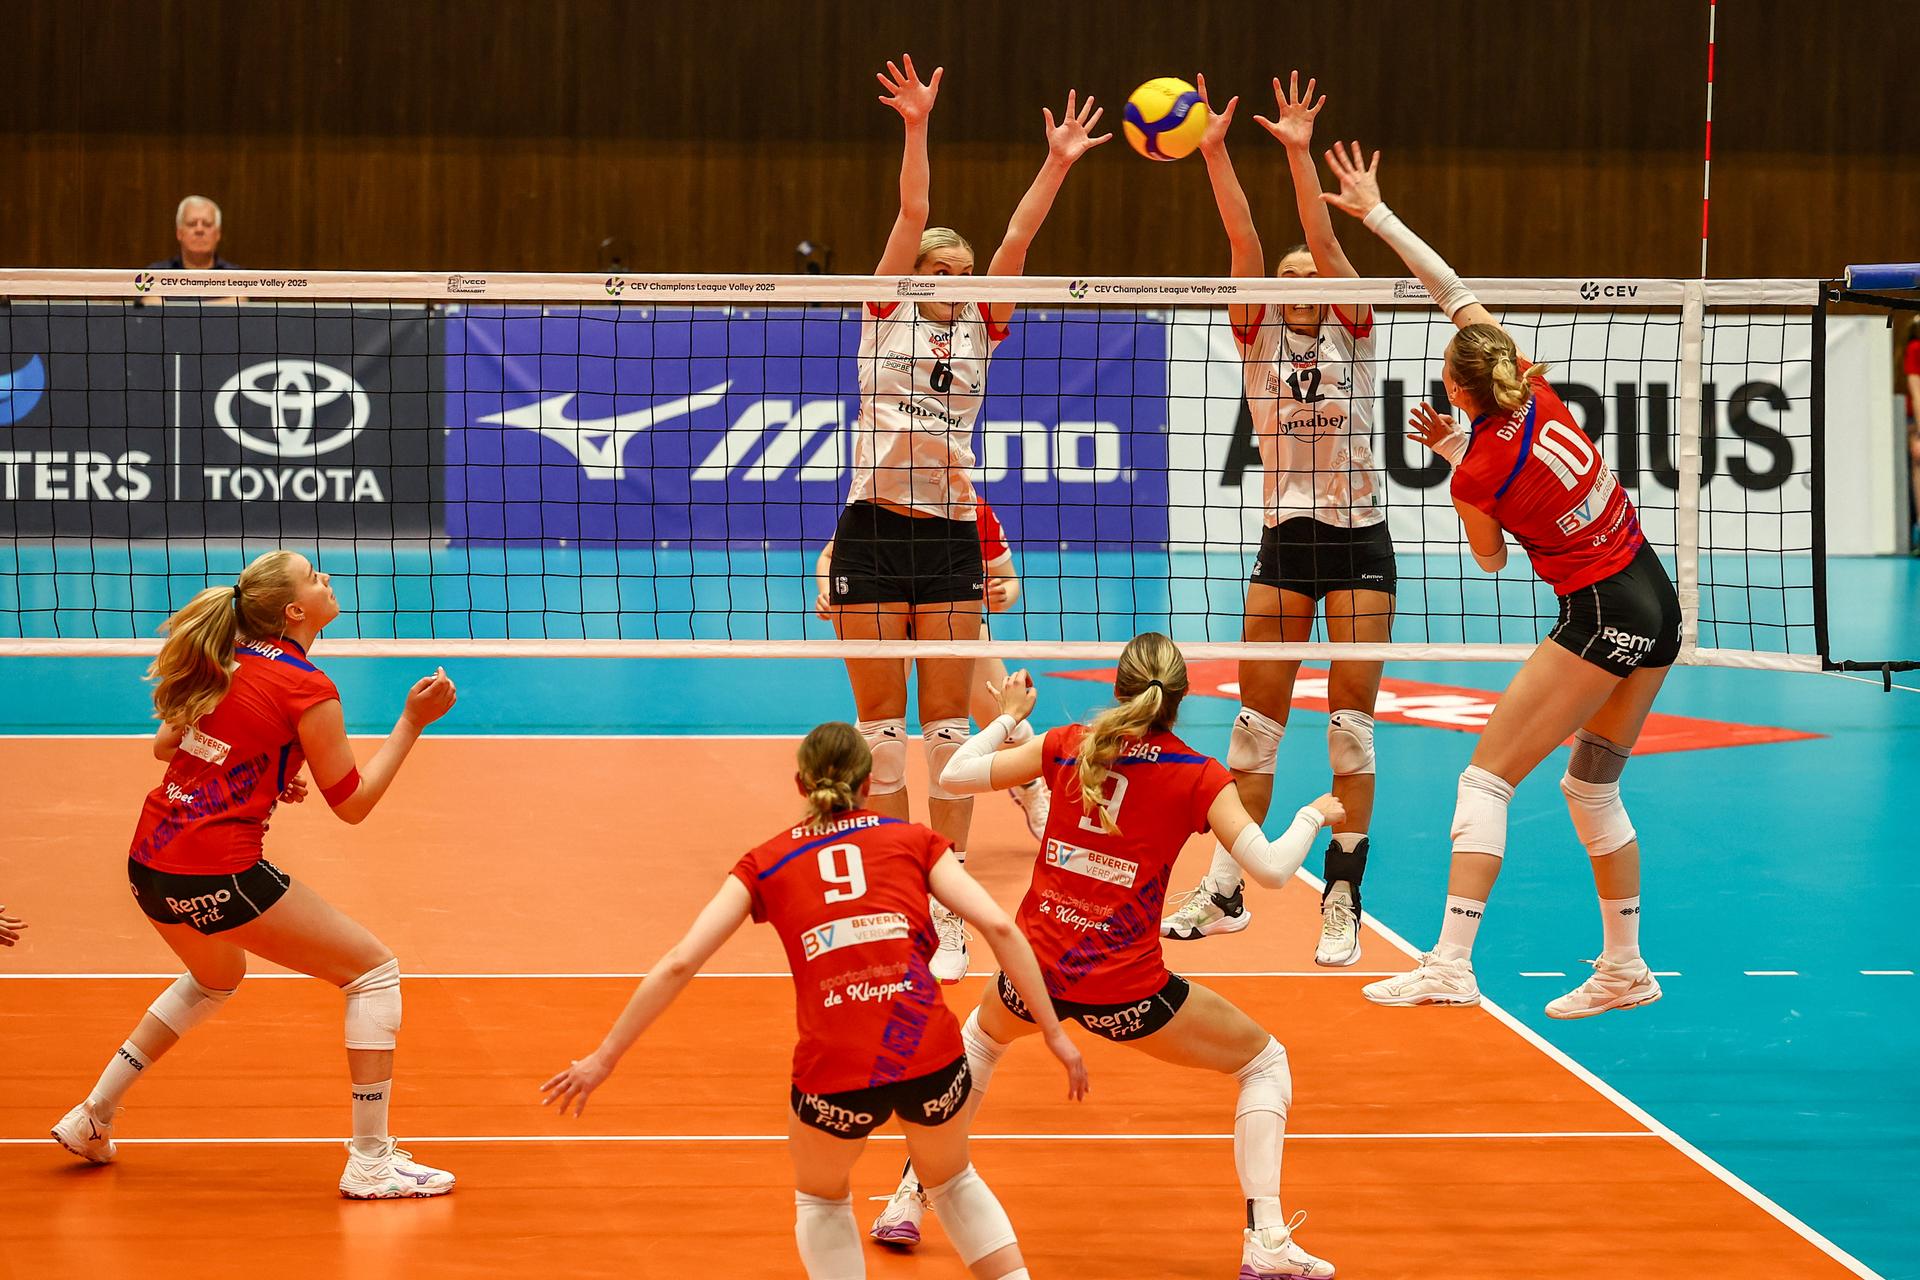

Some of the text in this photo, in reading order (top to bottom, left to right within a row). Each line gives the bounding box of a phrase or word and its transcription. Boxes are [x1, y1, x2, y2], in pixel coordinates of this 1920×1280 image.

[160, 278, 308, 289] CEV Champions League Volley 2025
[631, 282, 775, 293] CEV Champions League Volley 2025
[1094, 285, 1237, 295] CEV Champions League Volley 2025
[1603, 285, 1639, 298] CEV
[929, 361, 954, 393] 6
[1286, 368, 1326, 404] 12
[1532, 420, 1594, 492] 10
[203, 466, 386, 502] TOYOTA
[1607, 646, 1643, 666] Frit
[791, 815, 881, 840] STRAGIER
[816, 843, 868, 905] 9
[1088, 852, 1137, 874] BEVEREN
[165, 889, 231, 915] Remo
[190, 907, 225, 928] Frit
[1055, 904, 1111, 933] Klapper
[824, 981, 914, 1008] de Klapper
[1083, 999, 1152, 1030] Remo
[1110, 1017, 1145, 1039] Frit
[805, 1092, 873, 1126] Remo
[815, 1113, 852, 1133] Frit
